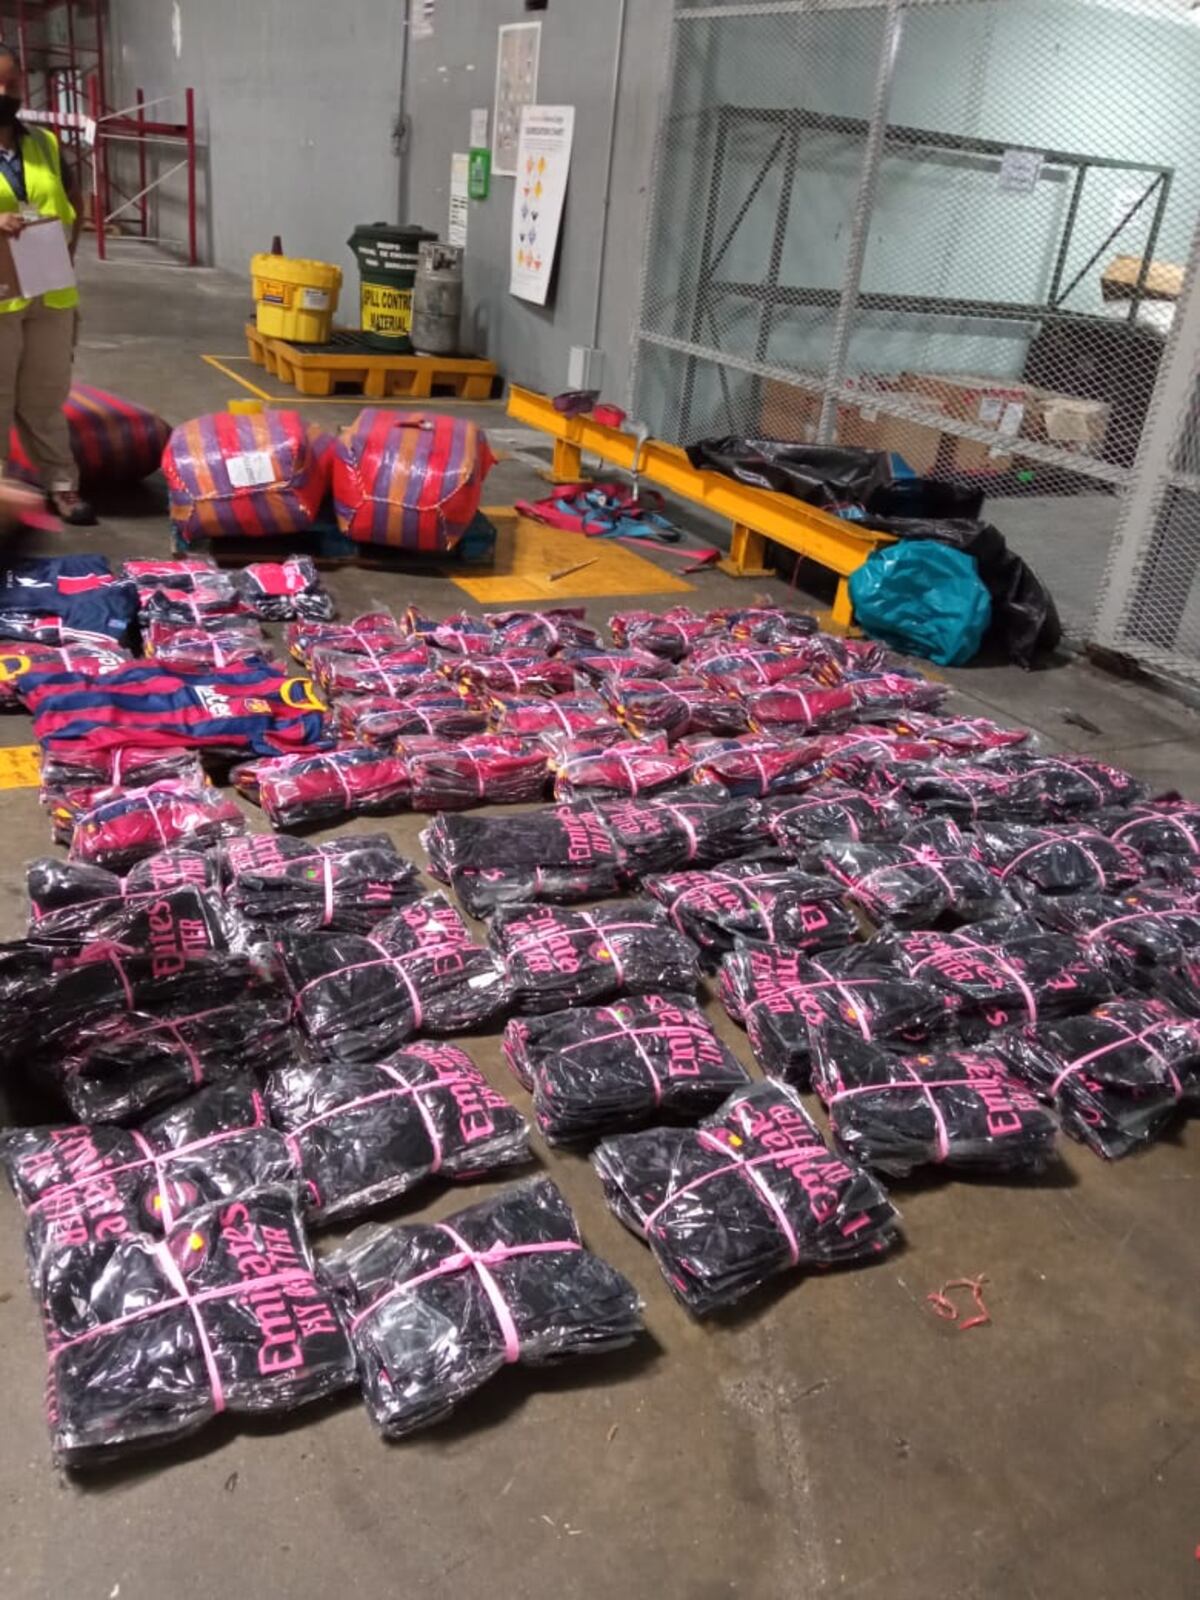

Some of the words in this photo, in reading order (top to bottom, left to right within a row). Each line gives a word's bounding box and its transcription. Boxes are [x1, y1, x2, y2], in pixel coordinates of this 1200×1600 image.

[382, 292, 413, 312] CONTRO
[731, 1101, 839, 1223] Emiates
[219, 1202, 305, 1375] Emiates
[293, 1303, 337, 1337] FLY
